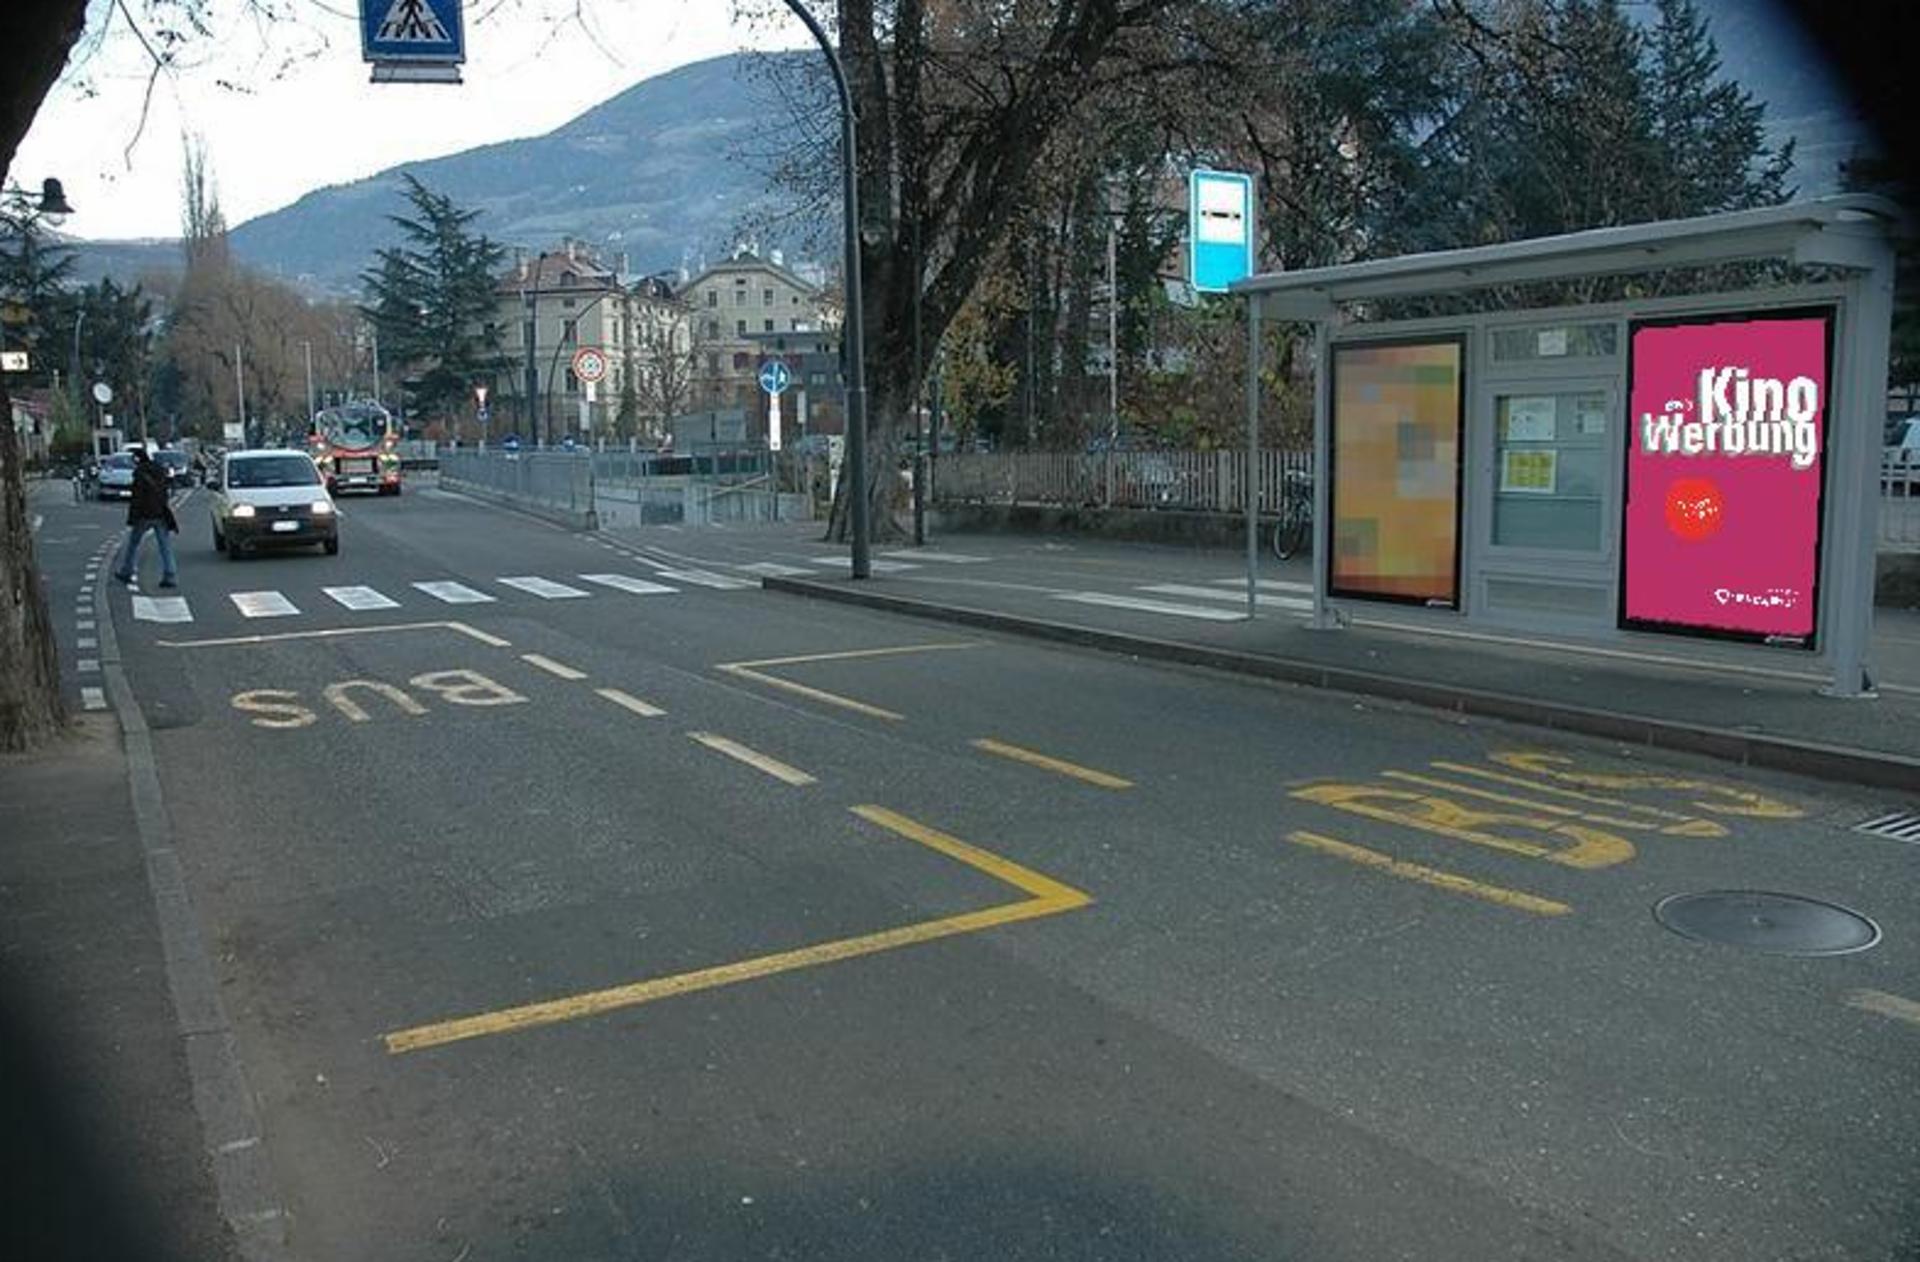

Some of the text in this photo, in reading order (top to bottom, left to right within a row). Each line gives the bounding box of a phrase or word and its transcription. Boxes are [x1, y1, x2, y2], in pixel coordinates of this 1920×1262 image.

[1700, 367, 1818, 423] Kino
[1643, 413, 1817, 467] Werbung
[231, 668, 531, 728] BUS
[1287, 749, 1803, 869] BUS
